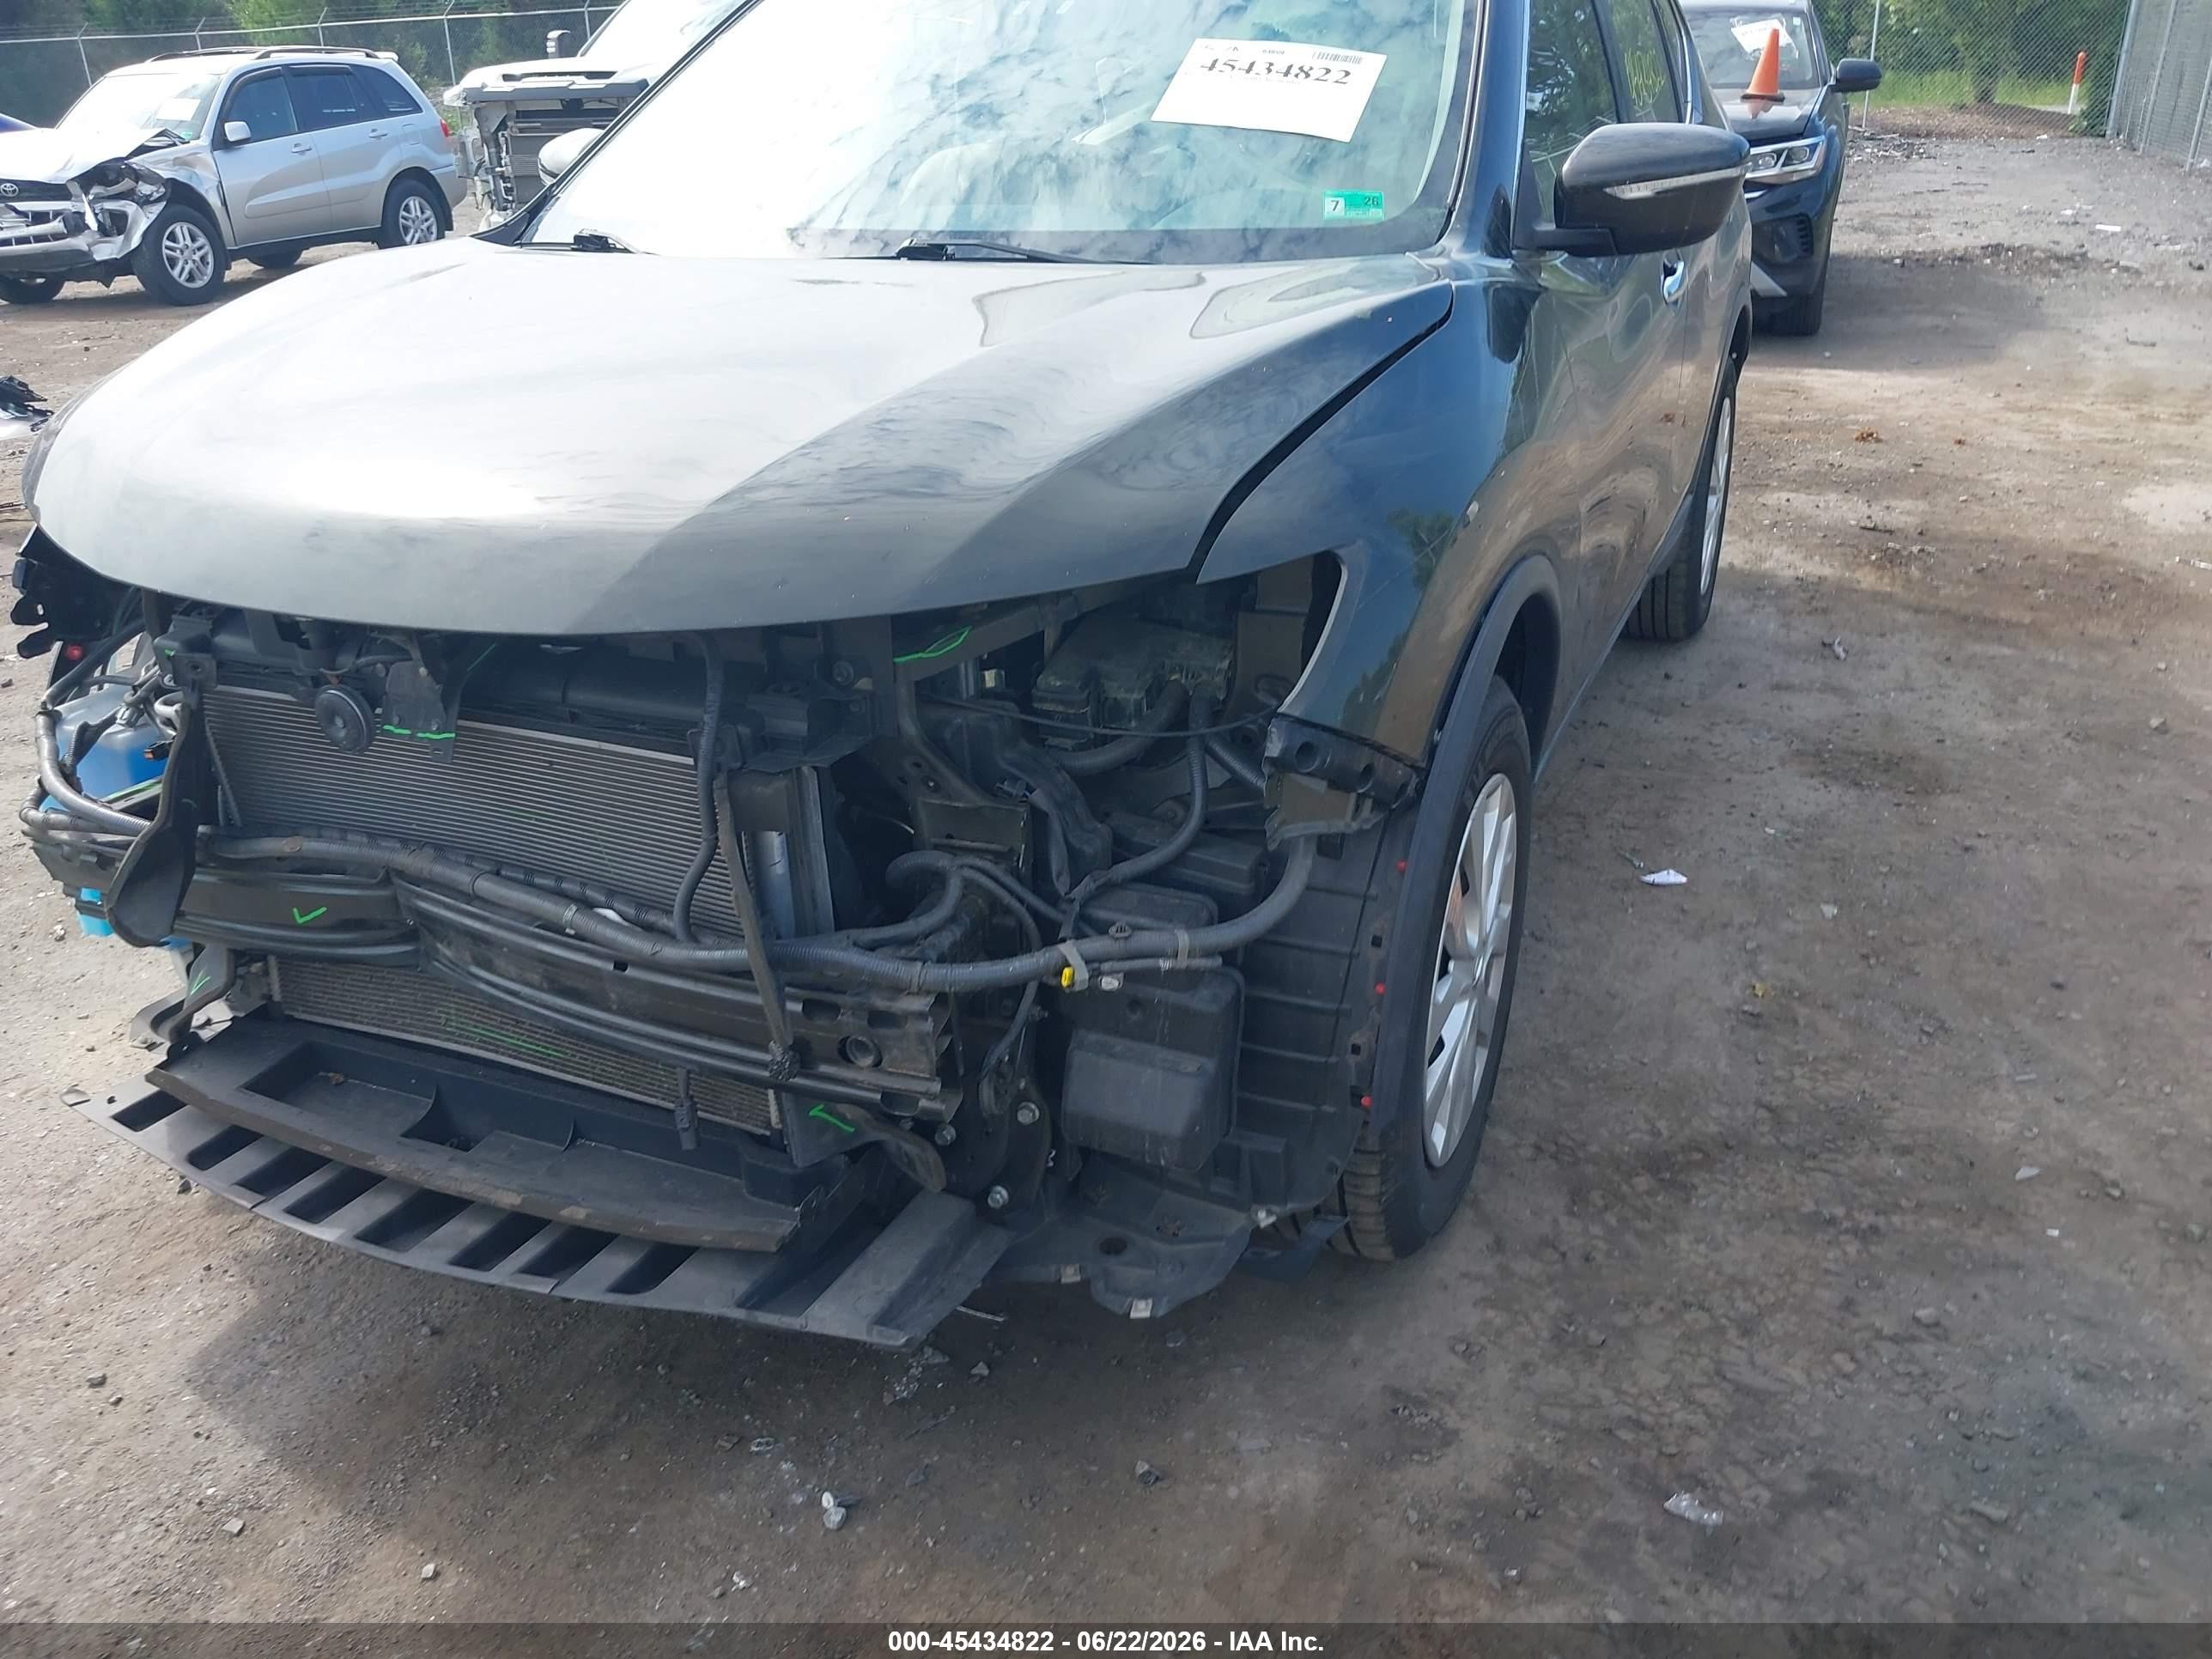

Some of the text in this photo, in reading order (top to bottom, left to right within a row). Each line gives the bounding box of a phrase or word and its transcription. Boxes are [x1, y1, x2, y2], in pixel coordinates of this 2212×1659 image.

[1200, 58, 1352, 84] 45434822
[1330, 199, 1340, 211] 7
[1364, 196, 1379, 206] 26
